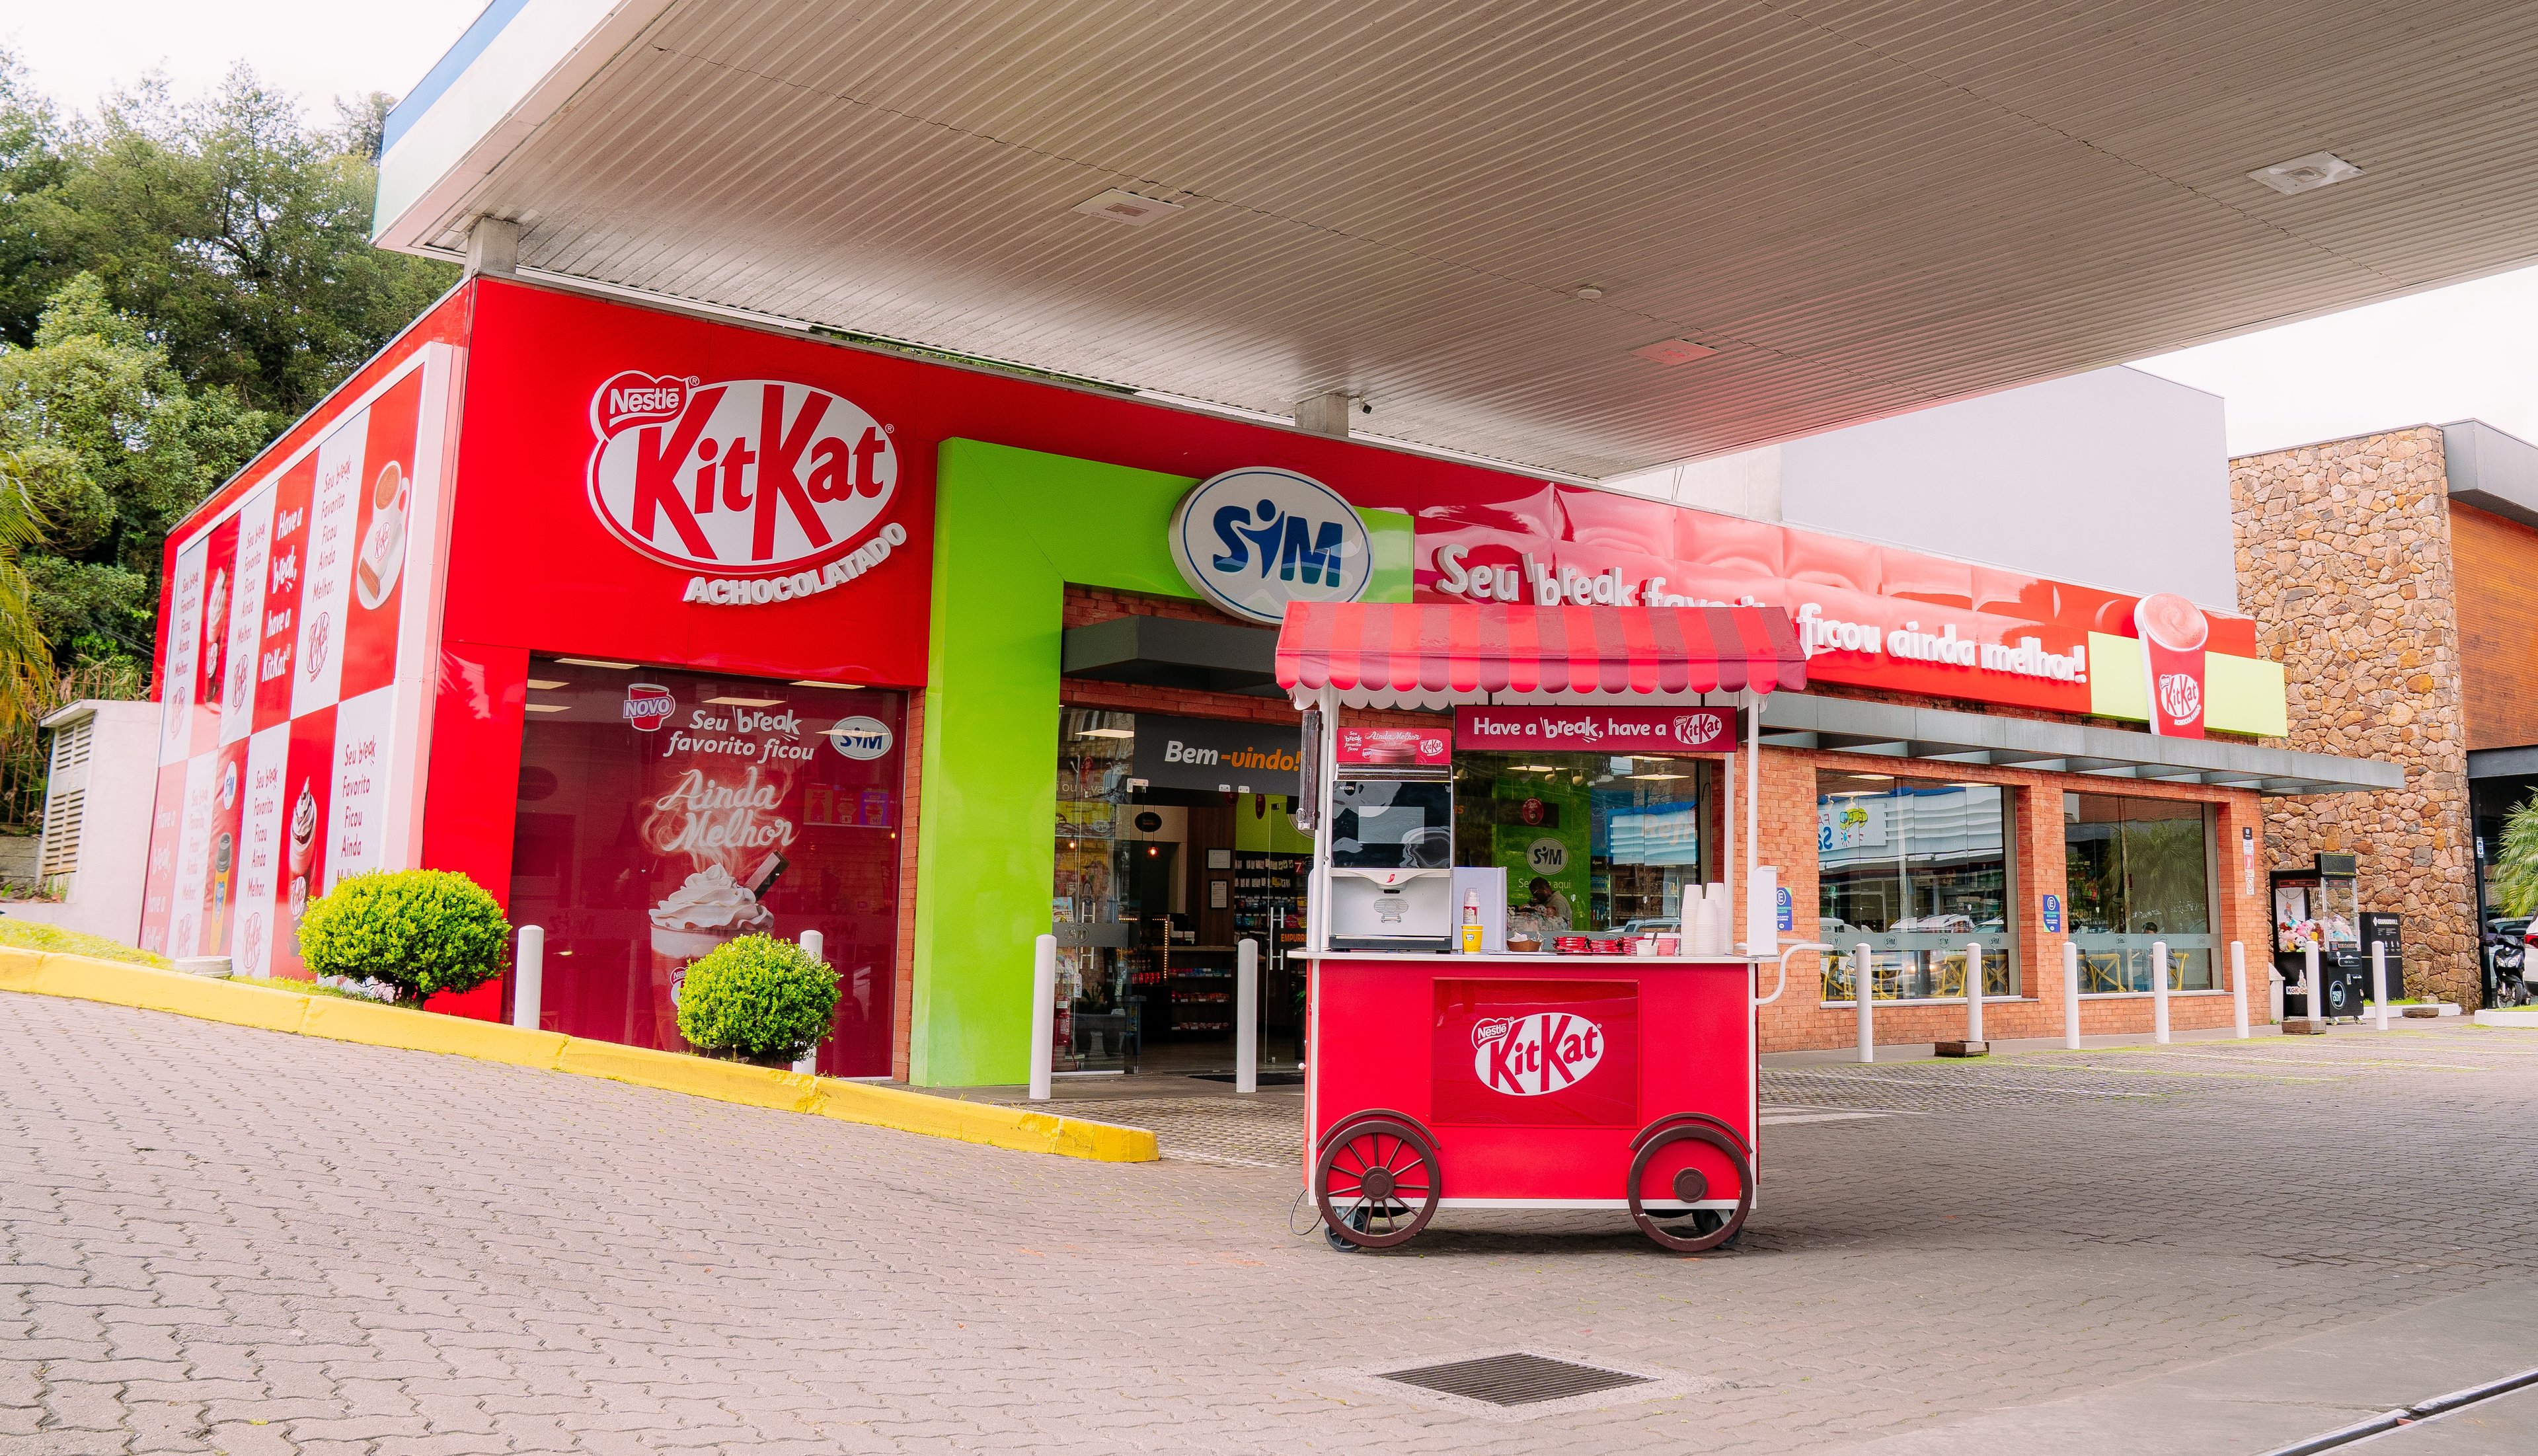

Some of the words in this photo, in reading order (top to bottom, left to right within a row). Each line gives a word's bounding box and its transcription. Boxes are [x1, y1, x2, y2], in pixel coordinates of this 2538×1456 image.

[610, 387, 679, 414] Nestlé
[324, 473, 334, 493] Seu
[336, 455, 351, 484] break
[631, 384, 886, 561] KitKat
[321, 494, 345, 520] Favorito
[278, 510, 297, 541] Have
[296, 507, 303, 527] a
[322, 524, 338, 545] Ficou
[1213, 499, 1343, 588] SIM
[317, 547, 336, 572] Ainda
[683, 522, 907, 605] ACHOCOLATADO
[1436, 544, 1519, 602] Seu
[1523, 552, 1636, 606] break
[266, 609, 284, 638] have
[284, 608, 291, 629] a
[1796, 603, 1881, 660] ficou
[1887, 621, 1976, 667] ainda
[1980, 636, 2087, 683] melhor!
[2166, 675, 2196, 716] KitKat
[625, 699, 670, 718] NOVO
[689, 710, 728, 732] Seu
[733, 707, 802, 735] break
[840, 727, 884, 751] SIM
[1474, 717, 1521, 736] Have
[1525, 722, 1537, 736] a
[1540, 716, 1603, 739] break,
[1608, 718, 1650, 736] have
[1655, 722, 1666, 736] a
[1681, 714, 1720, 744] KitKat
[344, 744, 356, 766] Seu
[358, 735, 376, 763] break
[663, 732, 755, 757] favorito
[757, 739, 814, 763] ficou
[1423, 740, 1442, 753] KitKat
[256, 771, 264, 790] Seu
[342, 775, 370, 798] Favorito
[656, 767, 780, 812] Ainda
[253, 795, 273, 816] Favorito
[344, 806, 362, 828] Ficou
[254, 824, 267, 843] Ficou
[660, 808, 799, 851] Melhor
[251, 849, 266, 868] Ainda
[341, 834, 362, 858] Ainda
[1533, 846, 1562, 865] SIM
[1553, 880, 1571, 891] aqui
[1778, 893, 1784, 903] E
[2050, 900, 2054, 908] E
[1478, 1023, 1507, 1040] Nestlé
[1490, 1015, 1598, 1094] KitKat
